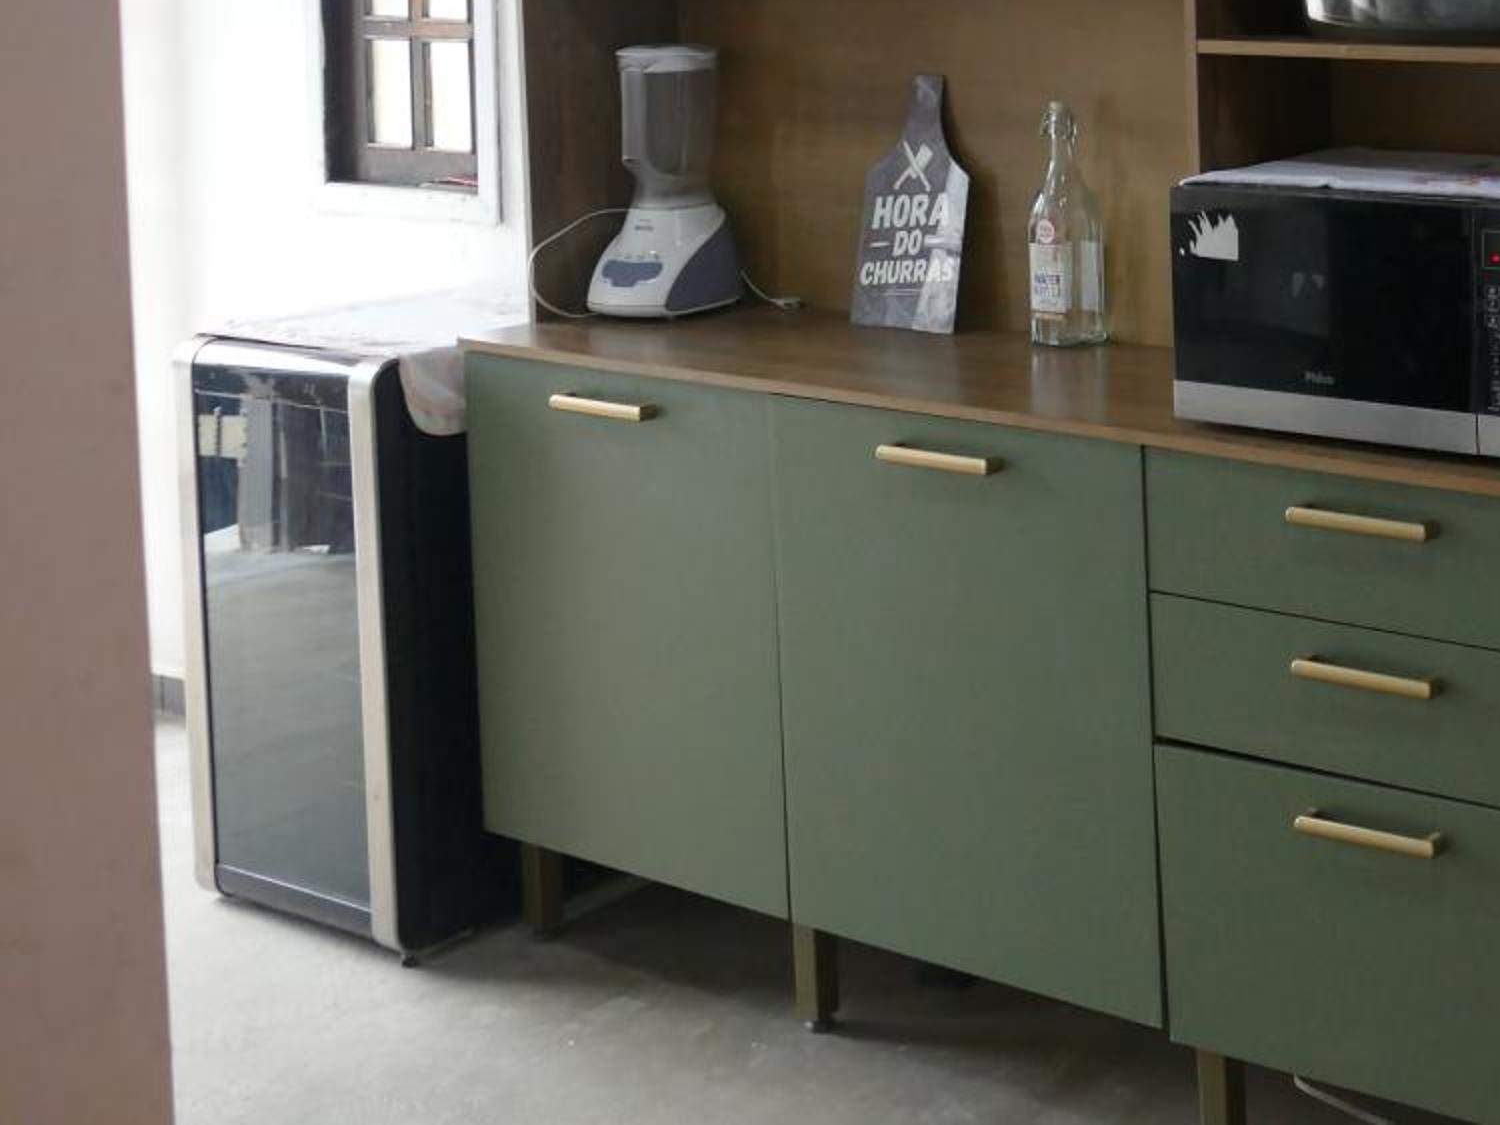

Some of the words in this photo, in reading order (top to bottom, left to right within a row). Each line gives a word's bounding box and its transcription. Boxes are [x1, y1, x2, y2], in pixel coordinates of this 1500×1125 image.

[872, 193, 949, 229] HORA
[893, 229, 922, 256] DO
[860, 258, 953, 285] CHURRAS
